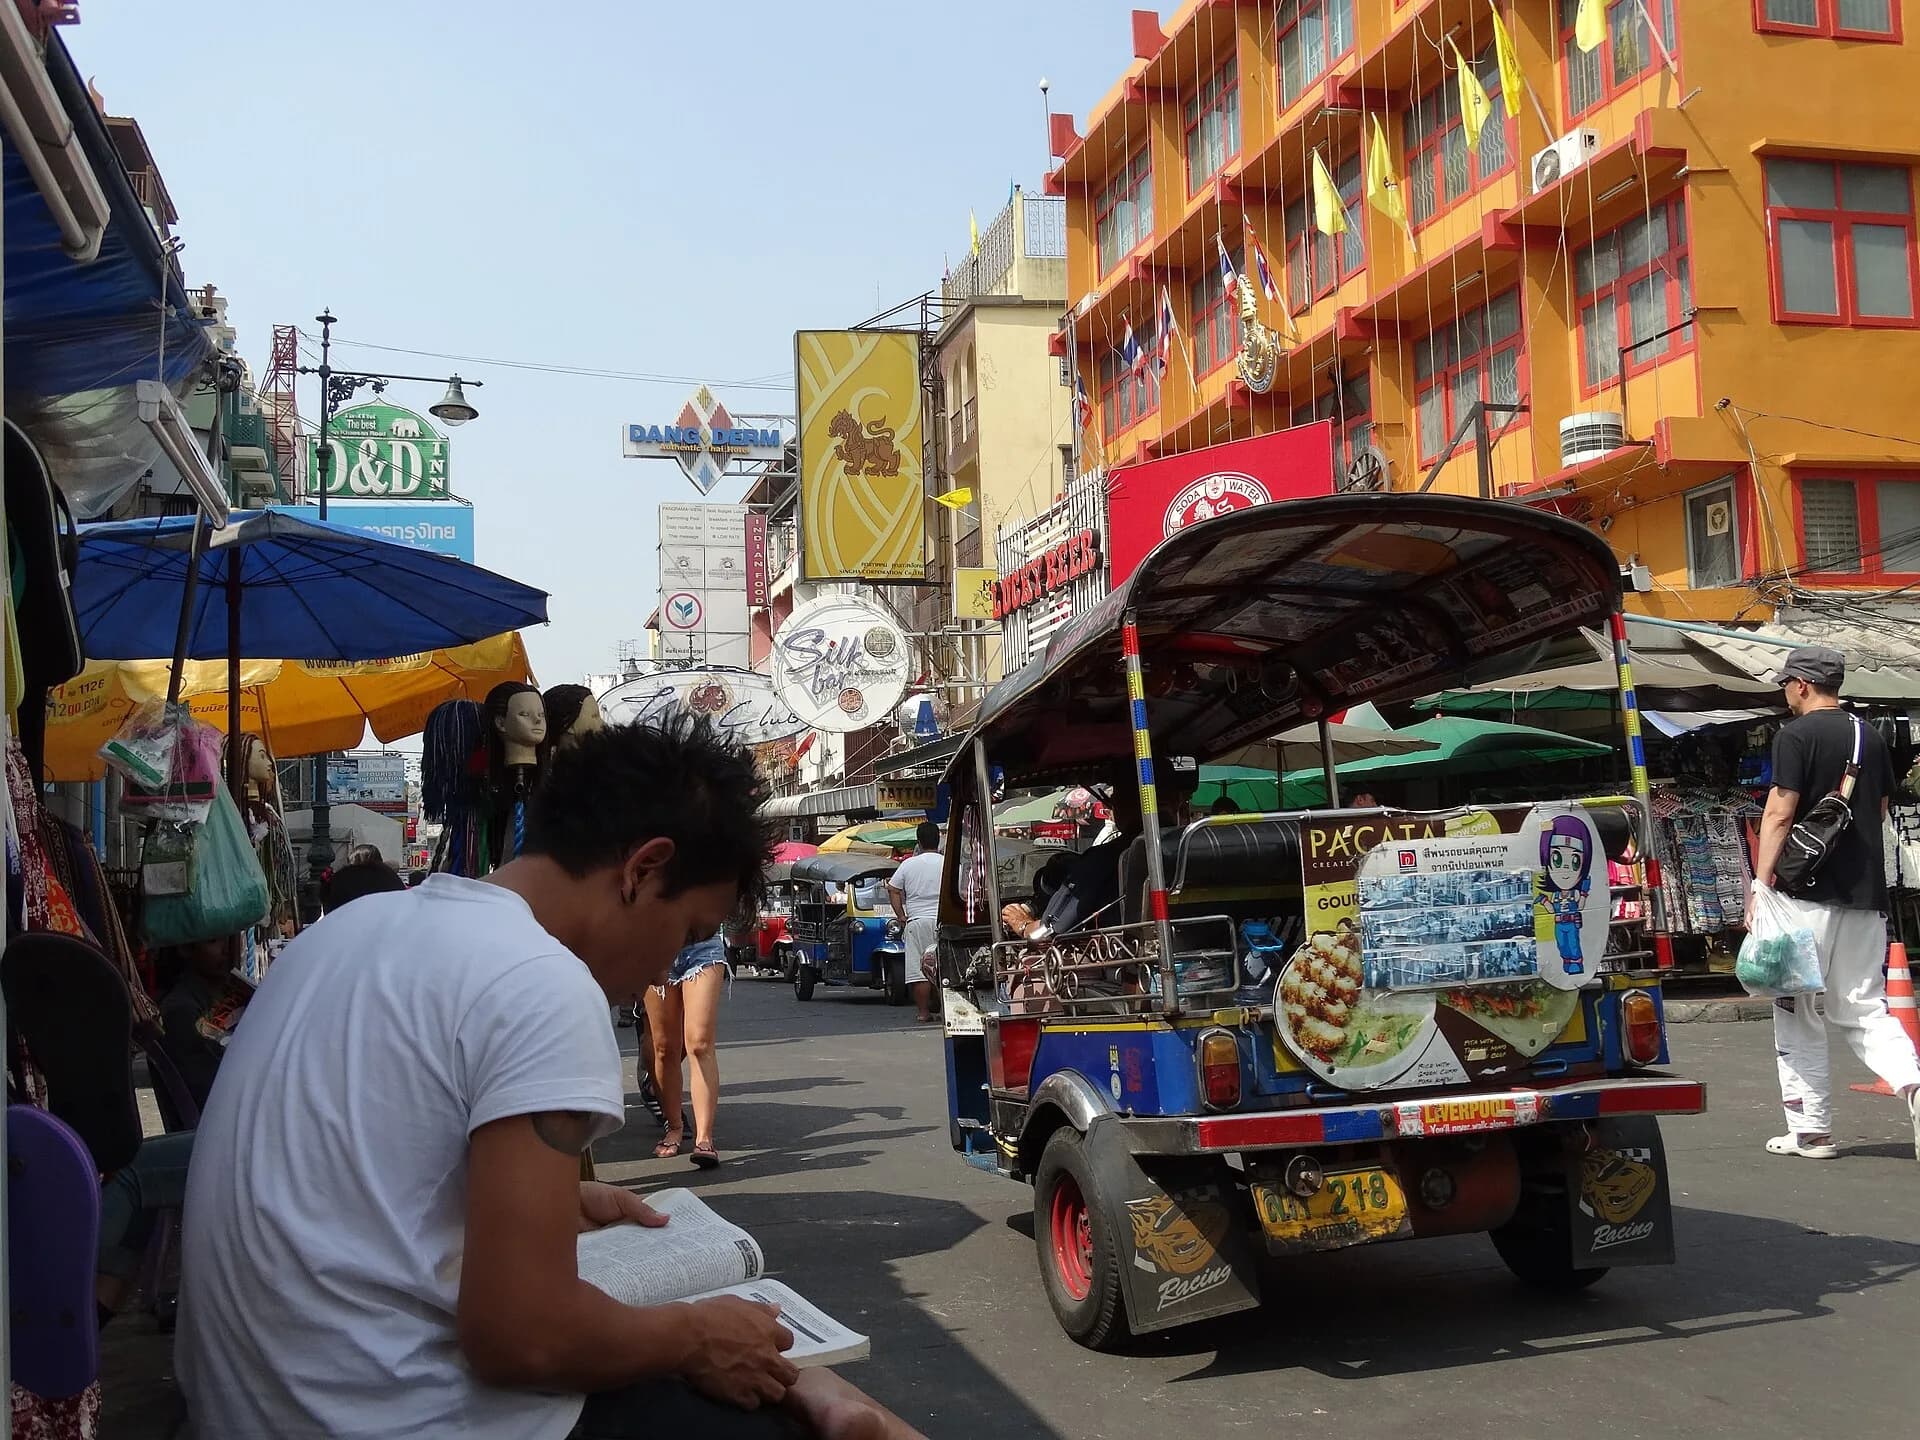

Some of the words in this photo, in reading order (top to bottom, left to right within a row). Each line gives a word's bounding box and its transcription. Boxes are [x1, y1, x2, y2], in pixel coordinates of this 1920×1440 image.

[347, 419, 360, 429] The
[361, 419, 377, 430] best
[630, 424, 700, 443] DANG
[712, 428, 780, 448] DERM
[659, 441, 702, 454] Authentic
[312, 439, 423, 496] D&D
[429, 442, 446, 492] INN
[1176, 490, 1201, 515] SODA
[1229, 481, 1260, 503] WATER
[753, 519, 763, 567] INDIAN
[755, 573, 764, 604] FOOD
[991, 556, 1042, 620] LUCKY
[1045, 528, 1097, 592] BEER
[783, 629, 863, 674] Silk
[811, 664, 850, 695] bar
[719, 700, 800, 728] Club
[880, 787, 934, 801] TATTOO
[1471, 820, 1492, 834] OPEN
[1424, 1098, 1509, 1124] LIVERPOOL
[1430, 1124, 1450, 1134] You'll
[1451, 1123, 1471, 1133] never
[1471, 1120, 1488, 1131] walk
[1328, 1172, 1389, 1215] 218
[1590, 1222, 1654, 1252] Racing
[1157, 1264, 1232, 1312] Racing
